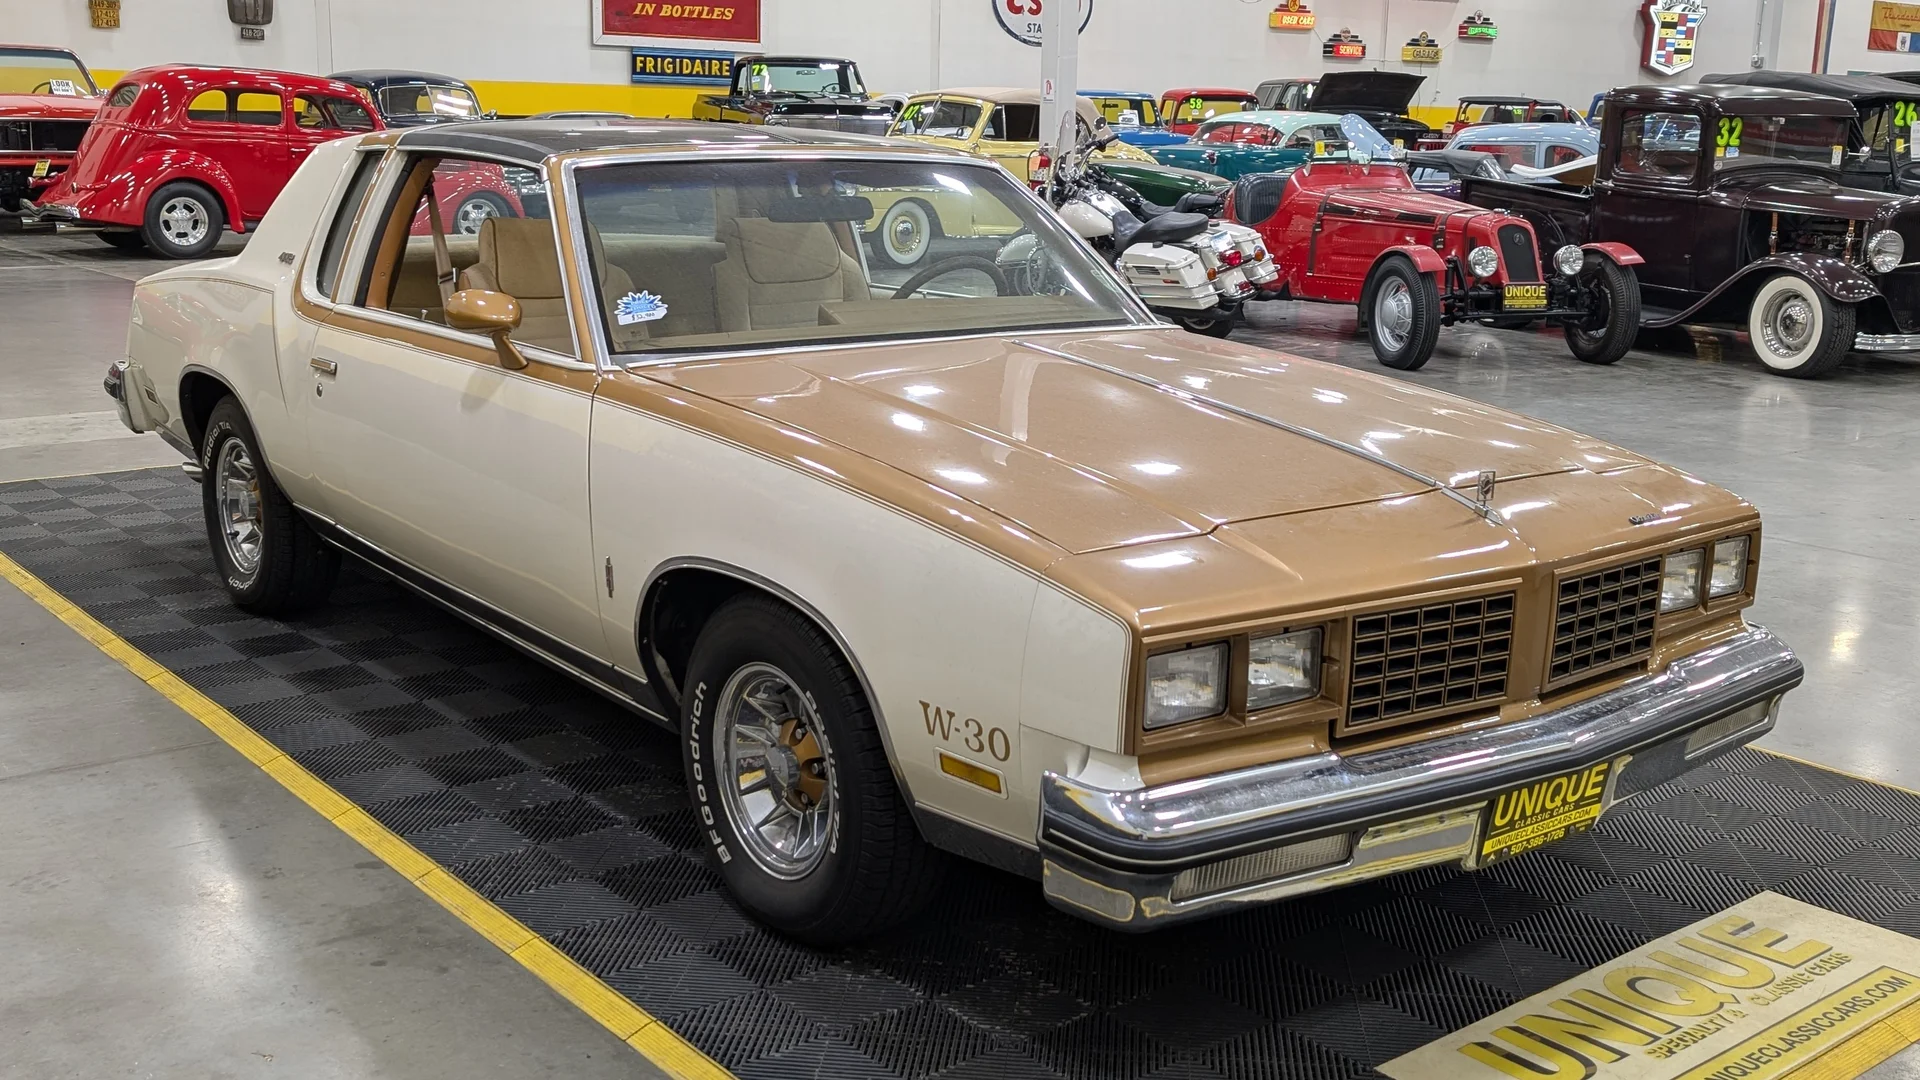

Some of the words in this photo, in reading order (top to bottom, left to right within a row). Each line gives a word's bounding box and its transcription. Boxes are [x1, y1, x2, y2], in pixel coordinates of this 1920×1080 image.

[633, 3, 656, 15] IN
[659, 4, 735, 20] BOTTLES
[1298, 16, 1315, 25] CARS
[1339, 44, 1363, 56] SERVICE
[1412, 49, 1439, 59] GARAGE
[635, 56, 731, 76] FRIGIDAIRE
[1189, 98, 1203, 110] 58
[1894, 101, 1918, 127] 26
[1716, 117, 1743, 147] 32
[1505, 285, 1546, 297] UNIQUE
[203, 424, 221, 470] Radial
[218, 420, 232, 431] T/A
[918, 699, 1012, 763] W-30
[688, 680, 732, 864] BFGoodrich
[1494, 762, 1609, 827] UNIQUE
[1490, 807, 1593, 850] UNIQUECLASSICCARS.COM
[1515, 812, 1551, 829] CLASSIC
[1552, 802, 1576, 816] CARS
[1510, 828, 1566, 855] 507-386-1726
[1456, 914, 1834, 1080] UNIQUE
[1643, 1011, 1733, 1060] SPECIALTY
[1747, 972, 1816, 1007] CLASSIC
[1804, 951, 1853, 978] CARS
